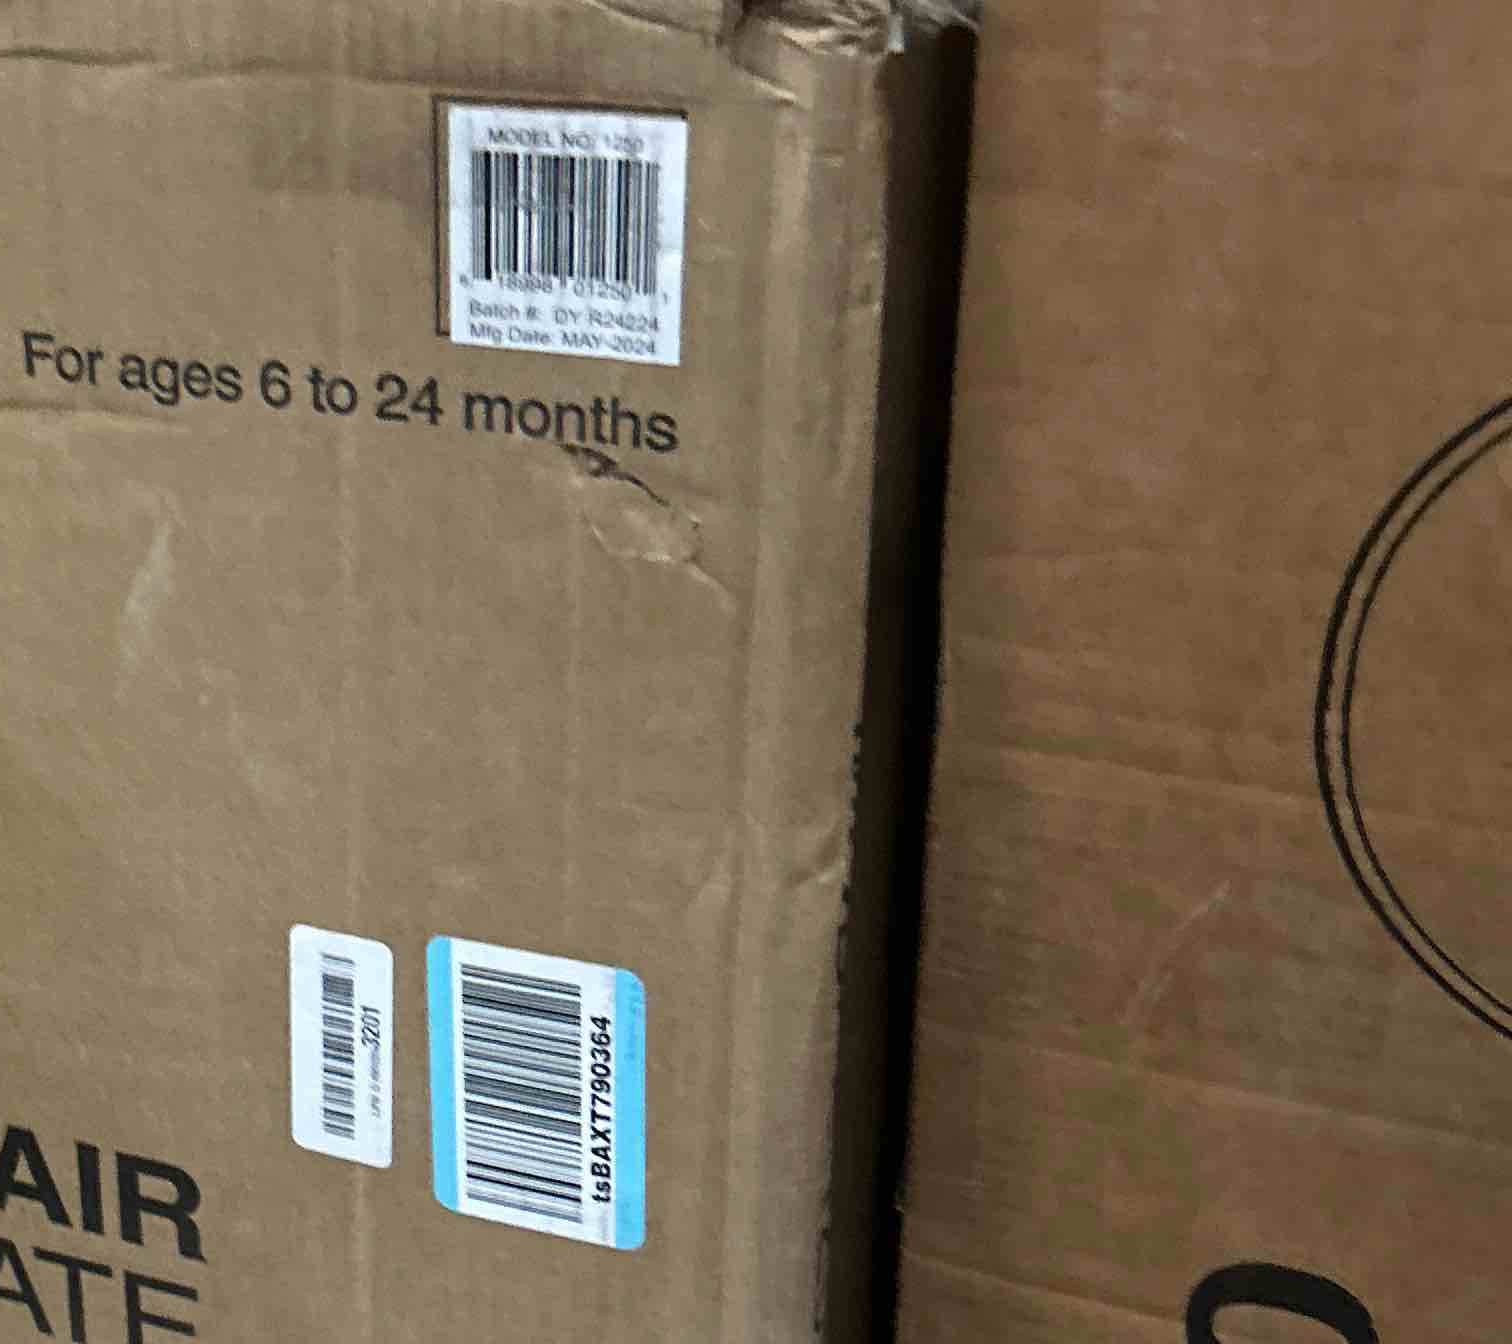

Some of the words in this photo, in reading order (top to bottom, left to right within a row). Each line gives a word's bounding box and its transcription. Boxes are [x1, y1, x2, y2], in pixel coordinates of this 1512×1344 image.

[488, 127, 554, 148] MODEL
[469, 298, 520, 320] Batch
[23, 330, 104, 386] For
[120, 355, 242, 406] ages
[259, 361, 292, 409] 6
[307, 367, 359, 416] to
[375, 373, 443, 426] 24
[464, 389, 679, 455] months
[591, 1016, 612, 1204] tsBAXT790364
